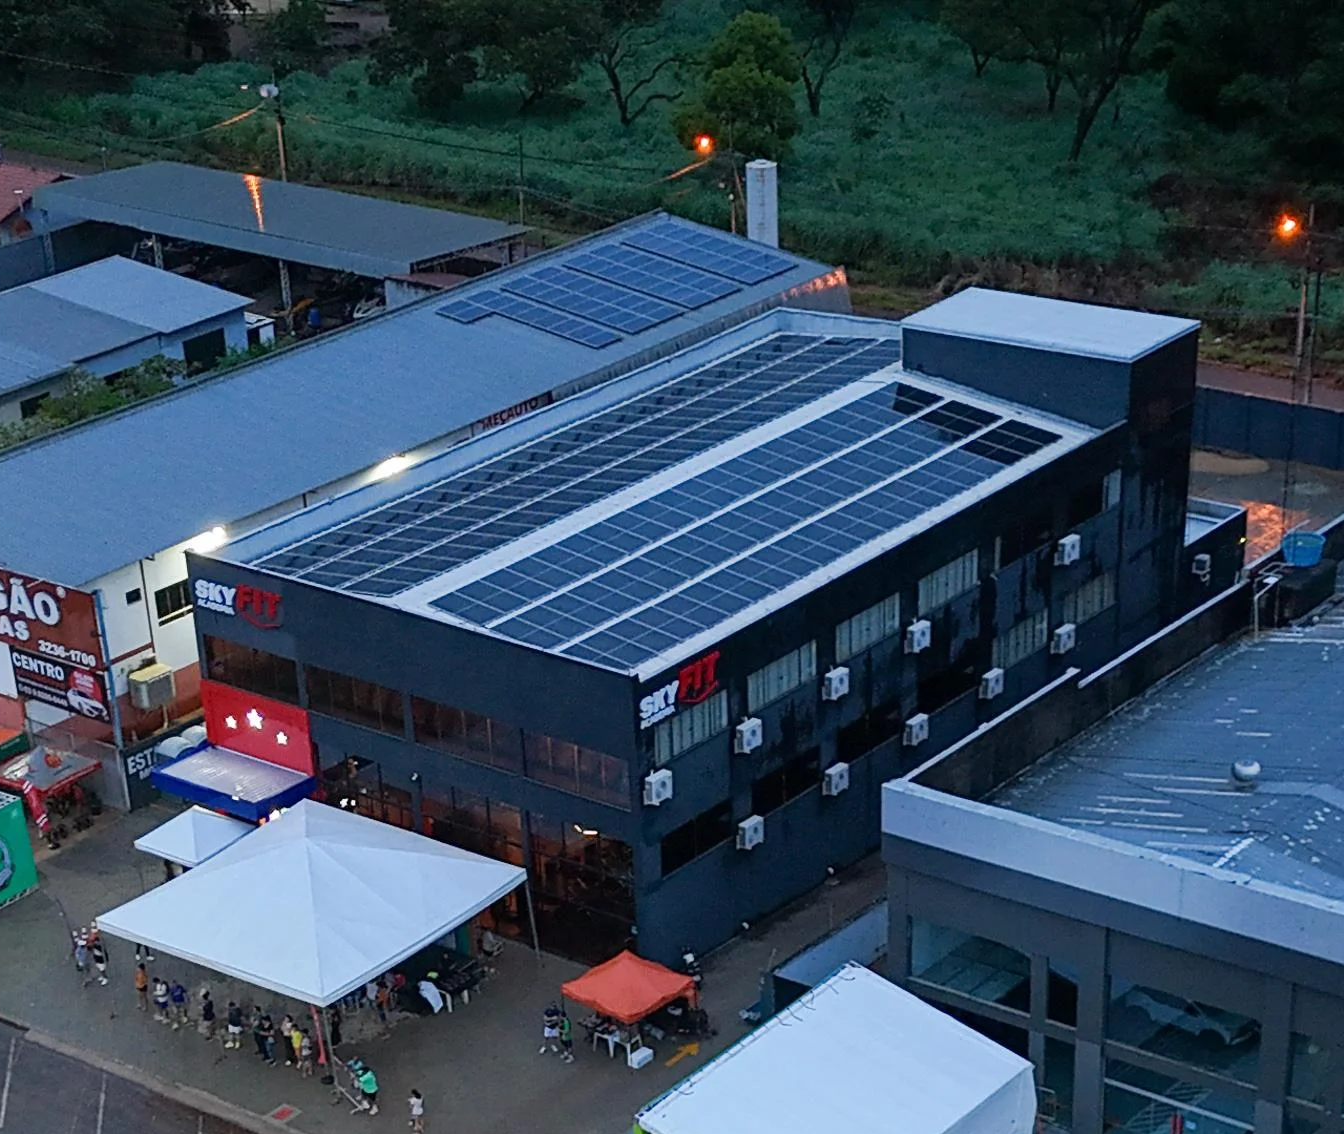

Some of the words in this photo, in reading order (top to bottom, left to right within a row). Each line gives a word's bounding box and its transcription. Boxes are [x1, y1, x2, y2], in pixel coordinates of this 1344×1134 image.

[194, 578, 237, 607] SKY
[236, 583, 282, 619] FIT
[11, 651, 65, 681] CENTRO
[37, 639, 97, 668] 3236-1700
[639, 679, 680, 719] SKY
[678, 651, 721, 700] FIT
